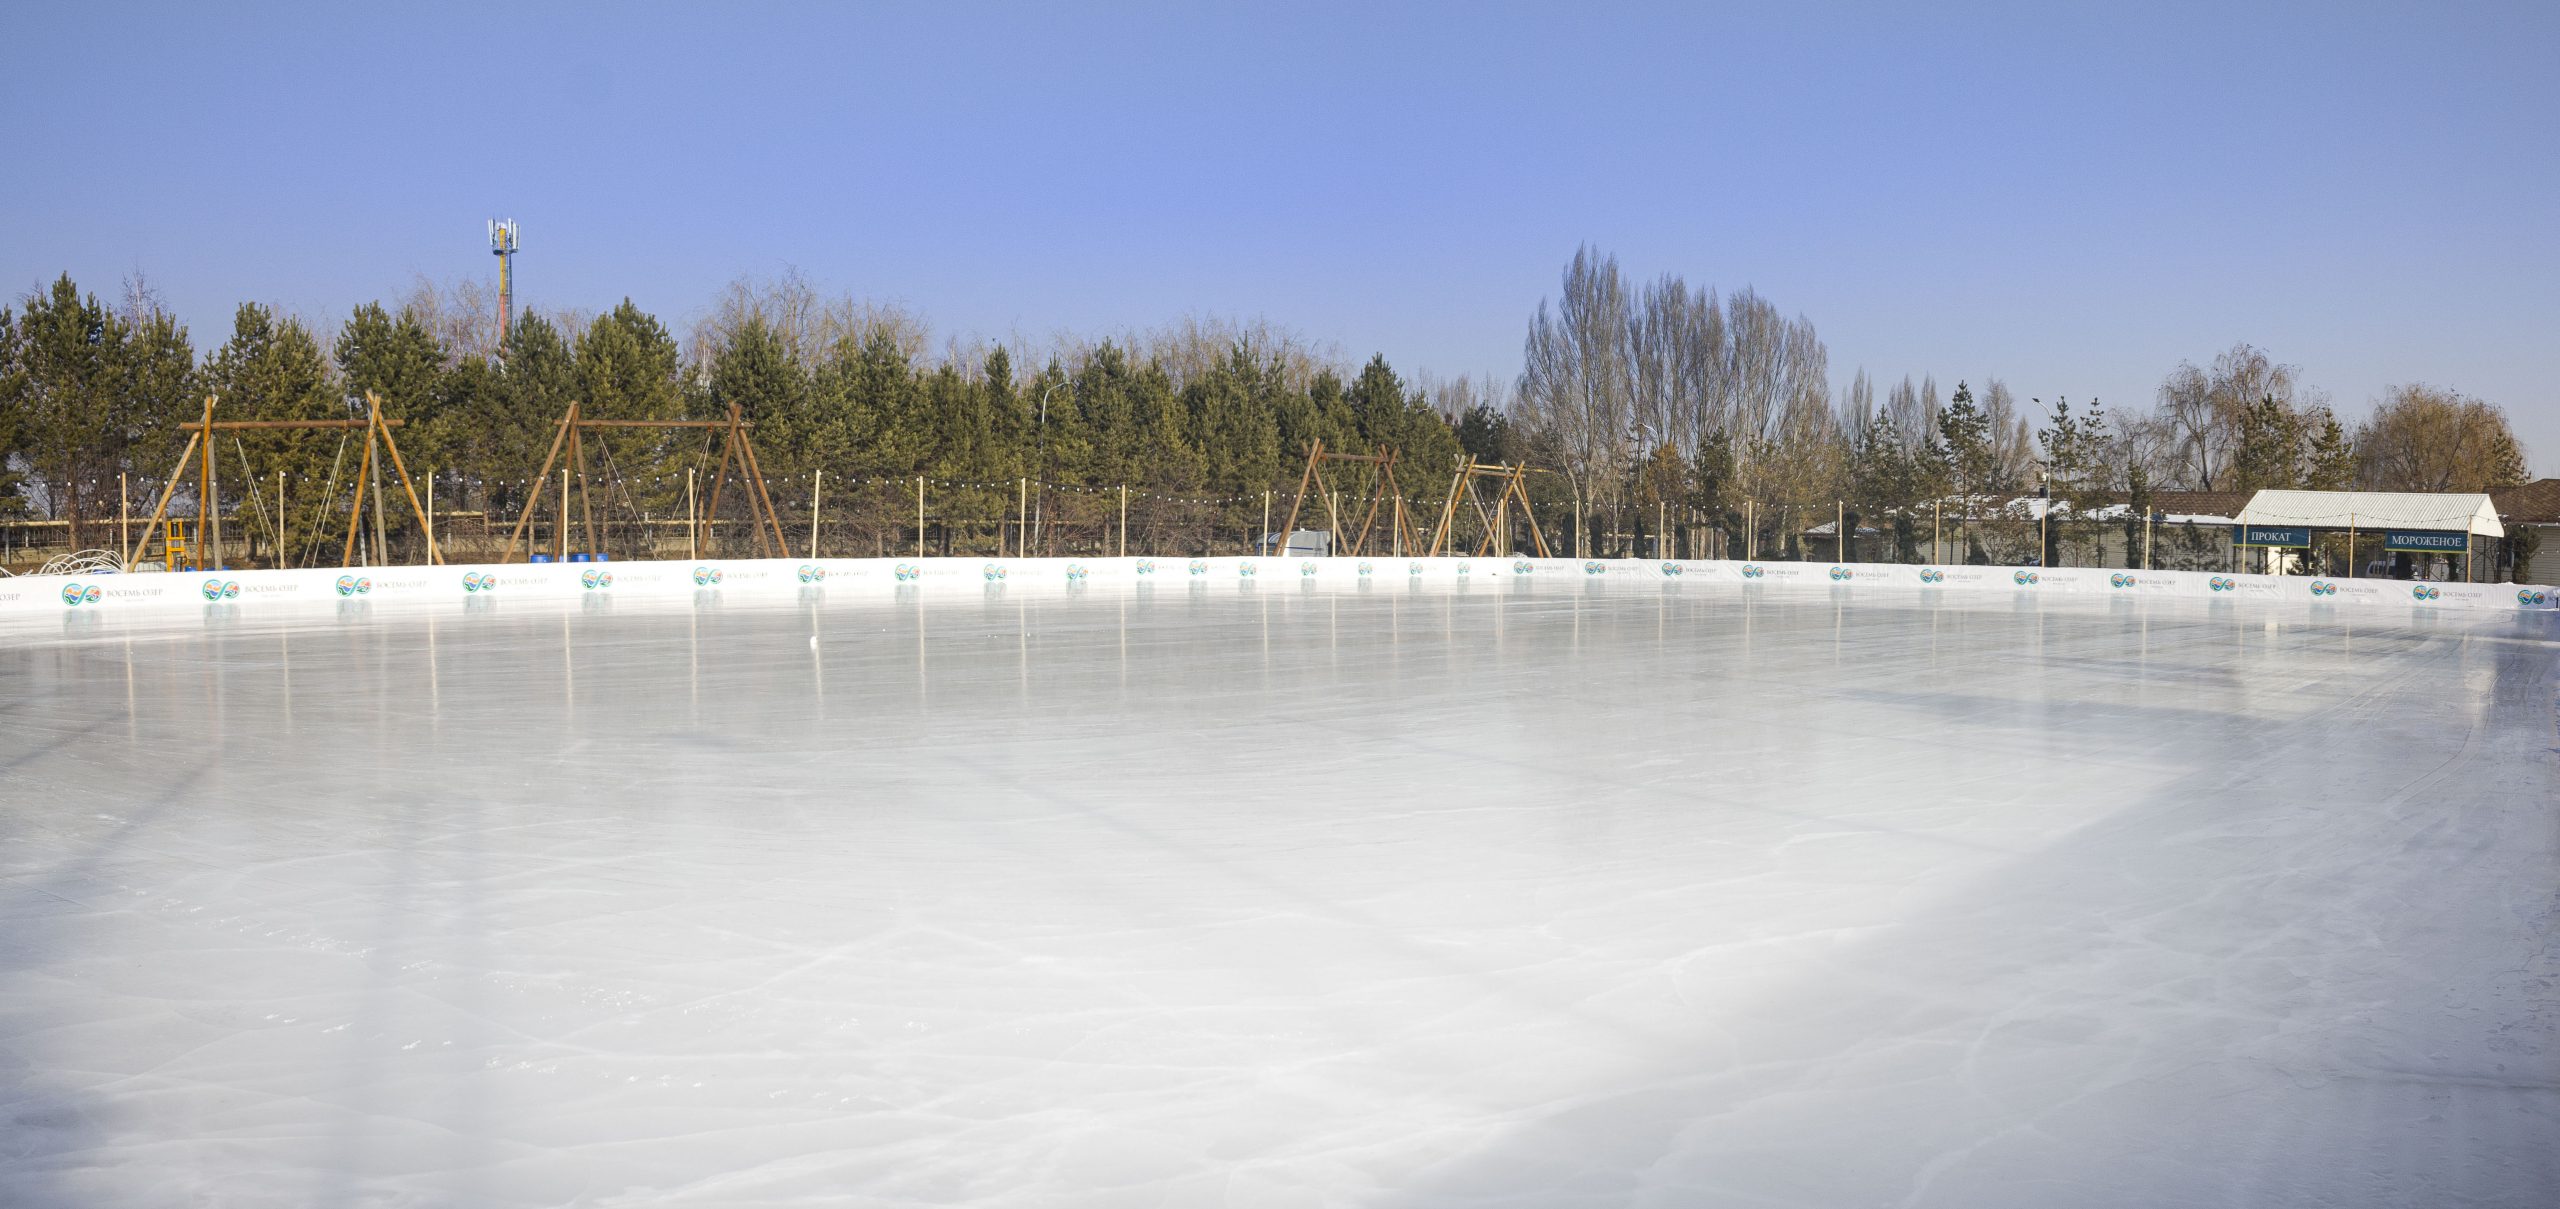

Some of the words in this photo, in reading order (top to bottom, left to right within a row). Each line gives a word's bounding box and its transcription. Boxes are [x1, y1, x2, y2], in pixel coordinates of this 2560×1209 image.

[2251, 531, 2291, 542] ПРОКАТ
[2392, 535, 2462, 547] МОРОЖЕНОЕ
[107, 589, 141, 597] ВОСЕМЬ
